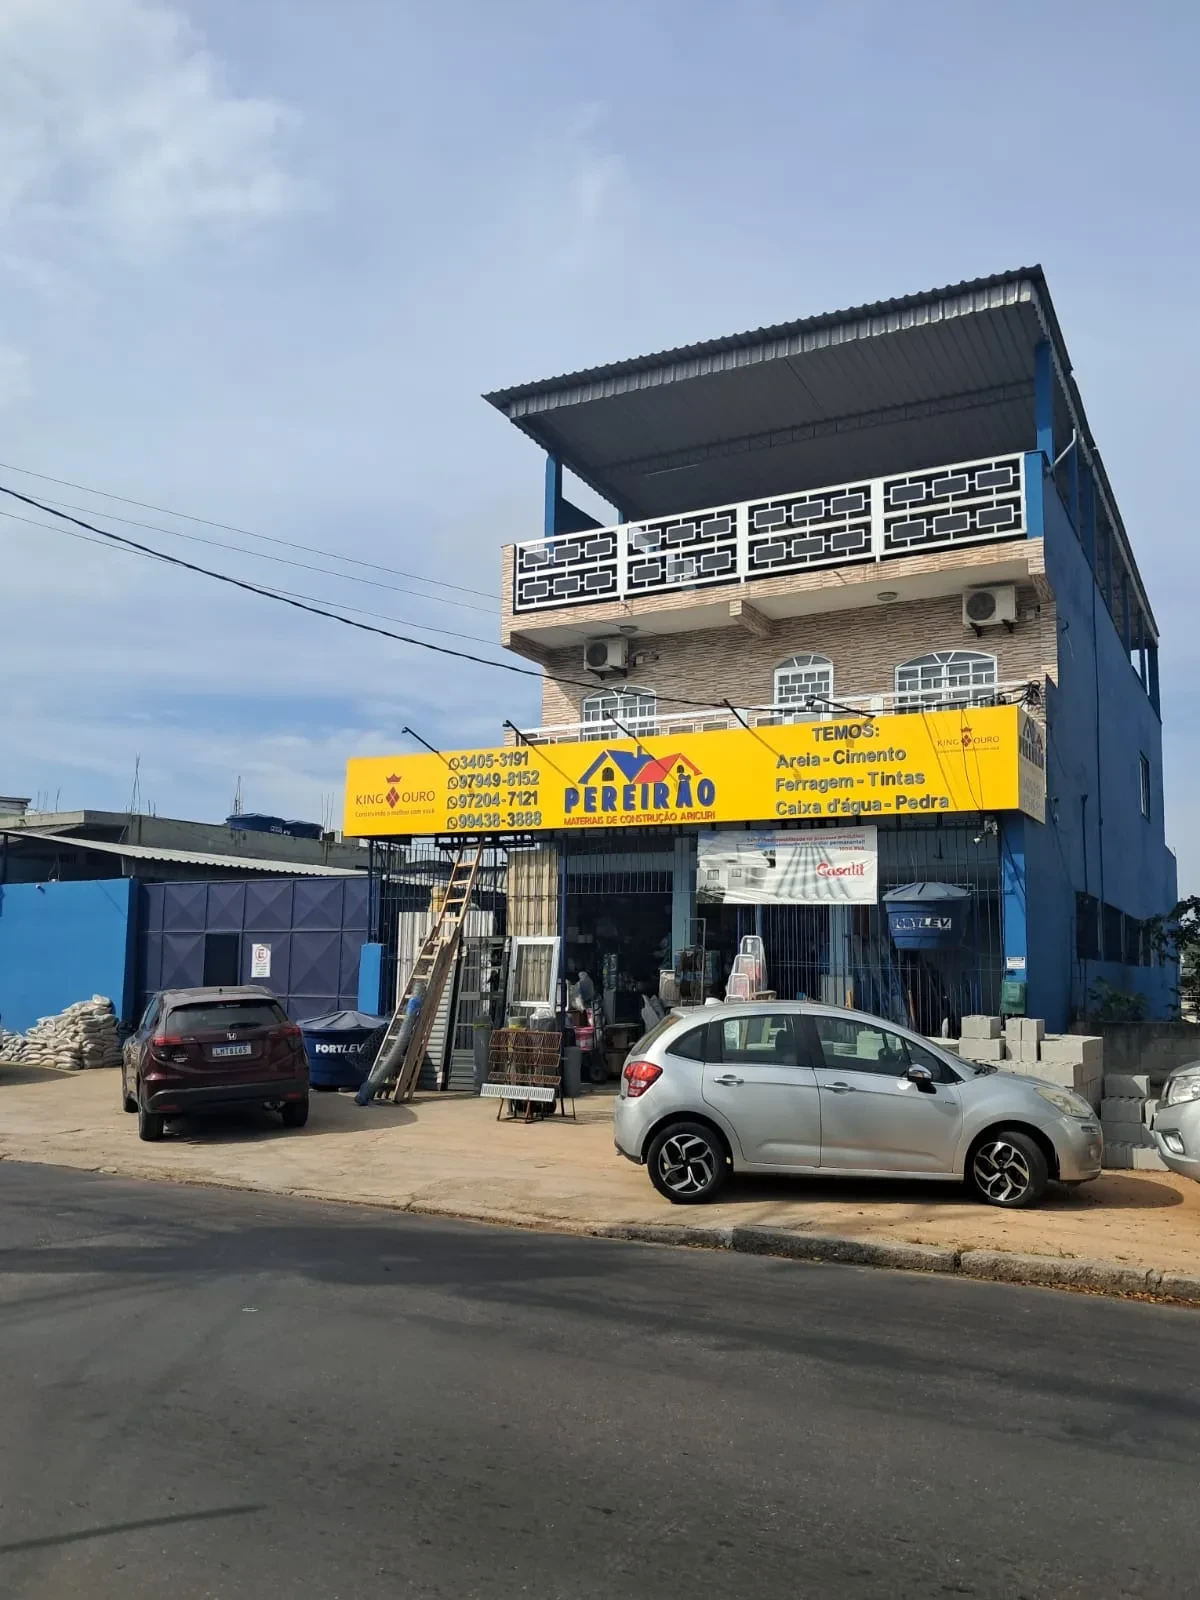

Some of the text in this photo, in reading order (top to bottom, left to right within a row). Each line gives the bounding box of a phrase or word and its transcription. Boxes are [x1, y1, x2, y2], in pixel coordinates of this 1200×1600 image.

[811, 722, 880, 742] TEMOS:
[973, 735, 1000, 744] OURO
[459, 751, 529, 769] 3405-3191
[776, 752, 821, 768] Areia
[832, 747, 907, 765] Cimento
[458, 770, 540, 788] 97949-8152
[775, 774, 854, 793] Ferragem
[867, 771, 926, 787] Tintas
[355, 790, 436, 806] KING OURO
[458, 790, 538, 808] 97204-7121
[564, 773, 715, 814] PEREIRÃO
[775, 799, 822, 816] Caixa
[826, 797, 882, 817] d'água
[895, 794, 949, 811] Pedra
[457, 810, 542, 828] 99438-3888
[563, 815, 604, 826] MATERIAIS
[606, 814, 617, 824] DE
[619, 811, 678, 824] CONSTRUÇÃO
[315, 1043, 365, 1053] FORTLEV
